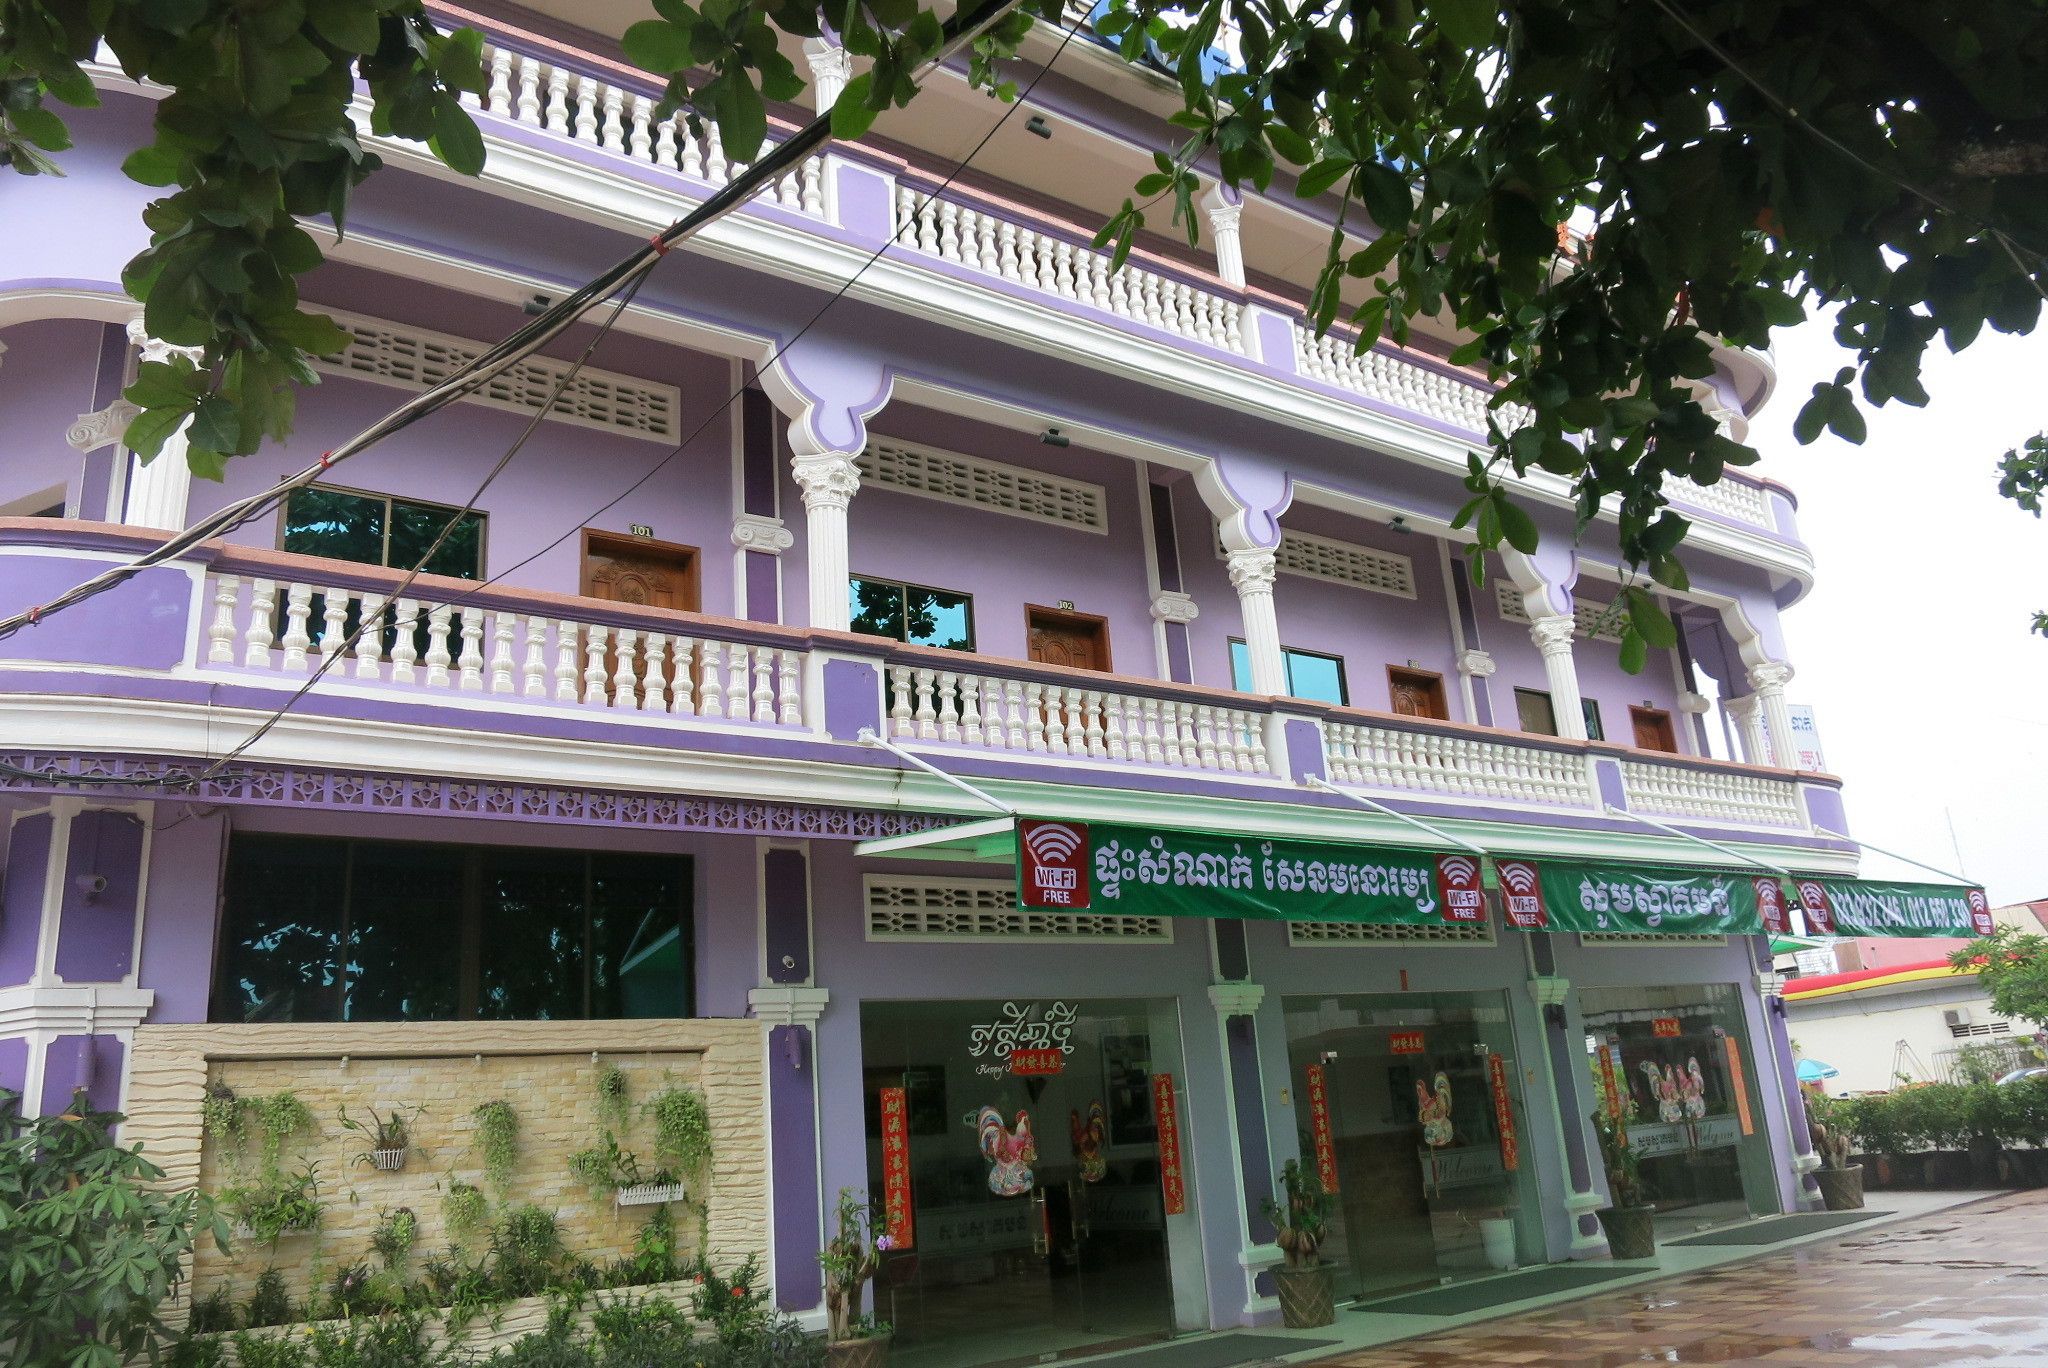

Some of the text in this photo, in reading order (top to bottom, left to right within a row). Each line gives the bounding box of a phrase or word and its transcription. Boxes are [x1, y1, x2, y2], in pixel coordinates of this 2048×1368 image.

[632, 525, 651, 537] 101
[1059, 600, 1073, 610] 102
[1095, 836, 1254, 899] ផ្ទះសំណាក់
[1038, 868, 1075, 888] Wi-Fi
[1043, 890, 1071, 904] FREE
[1449, 891, 1477, 905] Wi-Fi
[1512, 898, 1537, 911] Wi-Fi
[1453, 908, 1476, 919] FREE
[1907, 896, 1932, 928] 012
[1517, 914, 1537, 925] FREE
